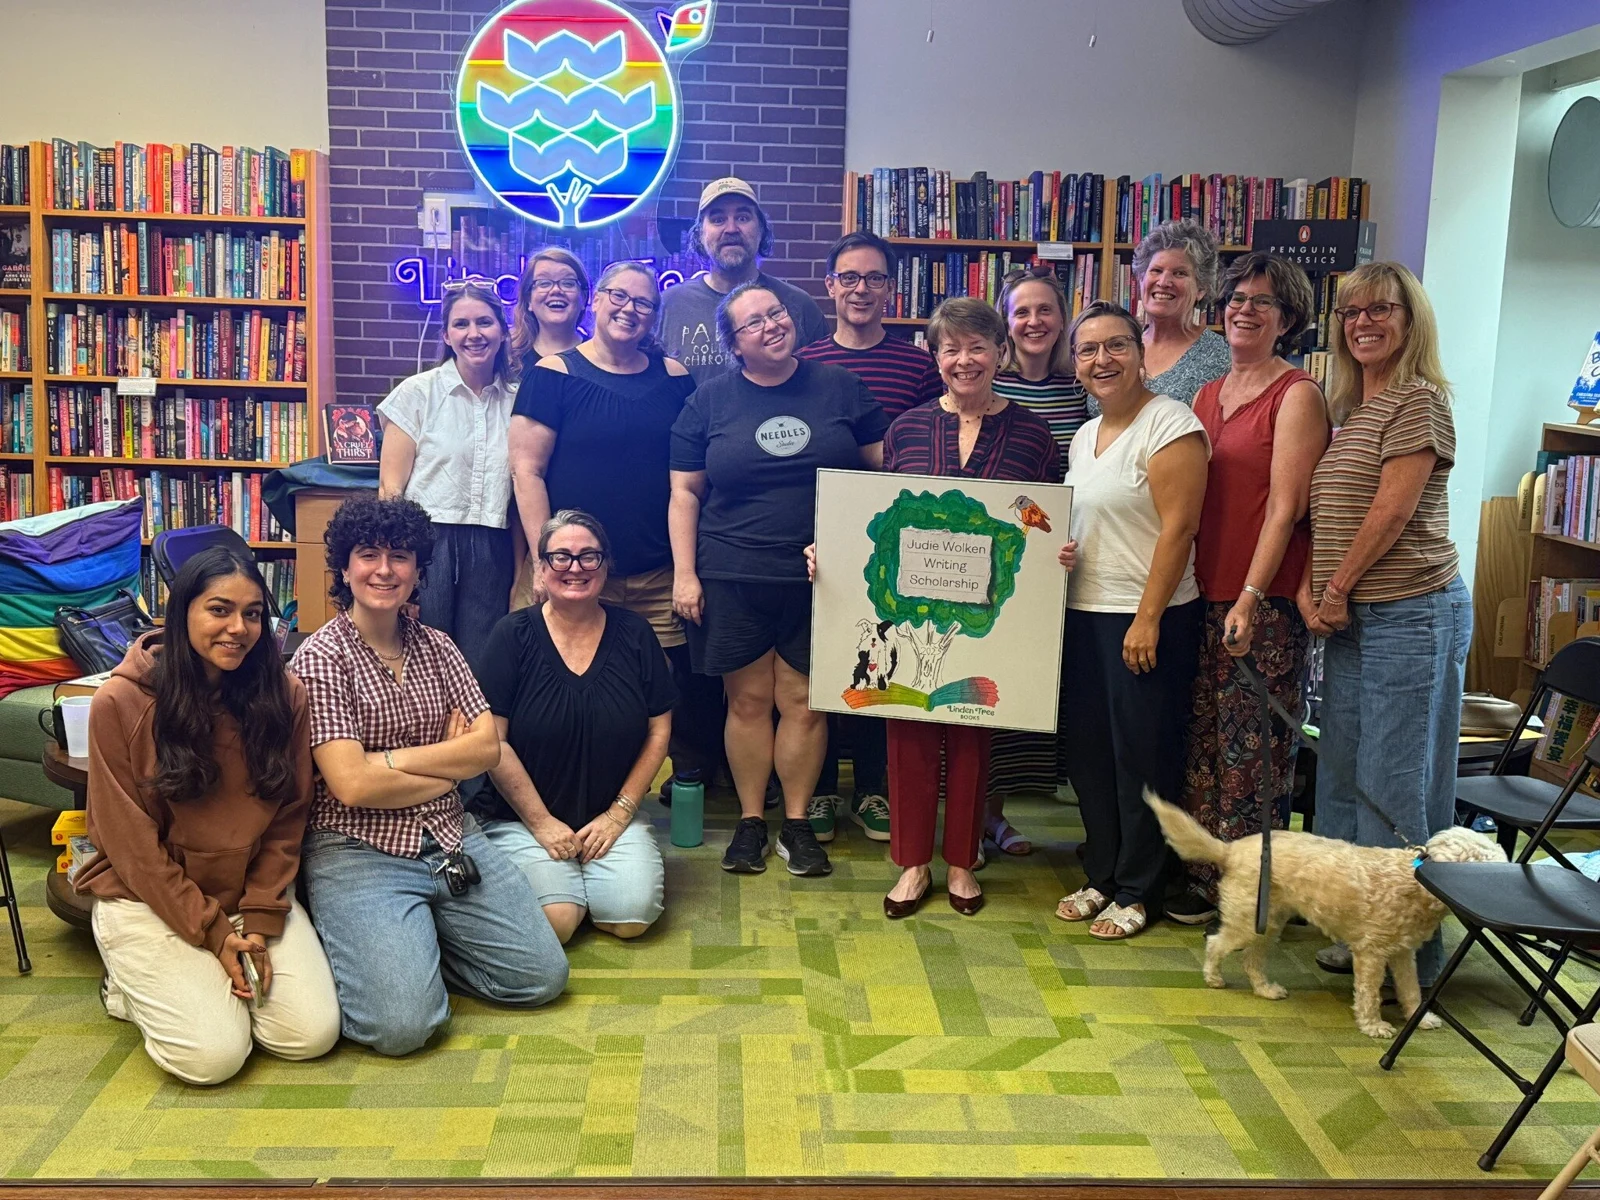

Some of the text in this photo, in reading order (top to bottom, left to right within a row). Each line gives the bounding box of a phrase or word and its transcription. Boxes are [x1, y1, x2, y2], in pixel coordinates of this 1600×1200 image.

[222, 157, 232, 209] RED SIDE STORY
[1270, 246, 1336, 254] PENGUIN
[682, 322, 722, 346] PAL
[684, 353, 737, 366] CHIROPR
[760, 428, 806, 440] NEEDLES
[336, 448, 372, 458] THIRST
[907, 540, 986, 554] Judie Wolken
[924, 558, 968, 574] Writing
[910, 574, 980, 592] Scholarship
[946, 705, 995, 716] Linden Tree
